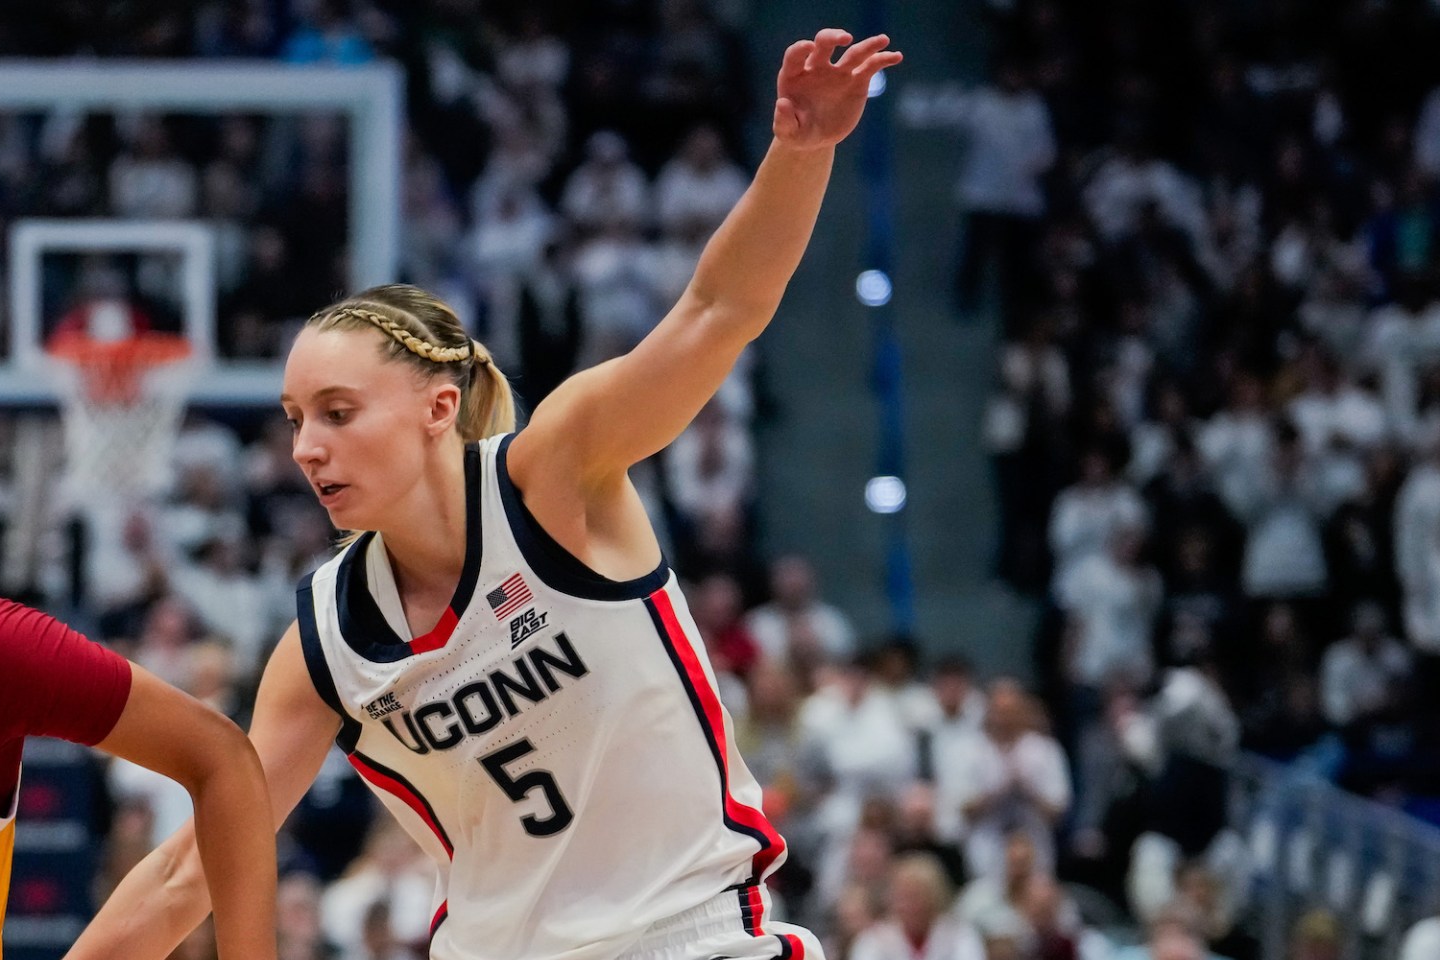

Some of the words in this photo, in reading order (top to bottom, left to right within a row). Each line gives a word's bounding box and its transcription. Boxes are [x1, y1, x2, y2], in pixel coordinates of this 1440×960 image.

[510, 607, 536, 632] BIG
[511, 611, 548, 644] EAST
[365, 701, 378, 713] BE
[377, 691, 396, 708] THE
[383, 630, 590, 755] UCONN
[368, 701, 404, 720] CHANGE
[477, 736, 575, 839] 5
